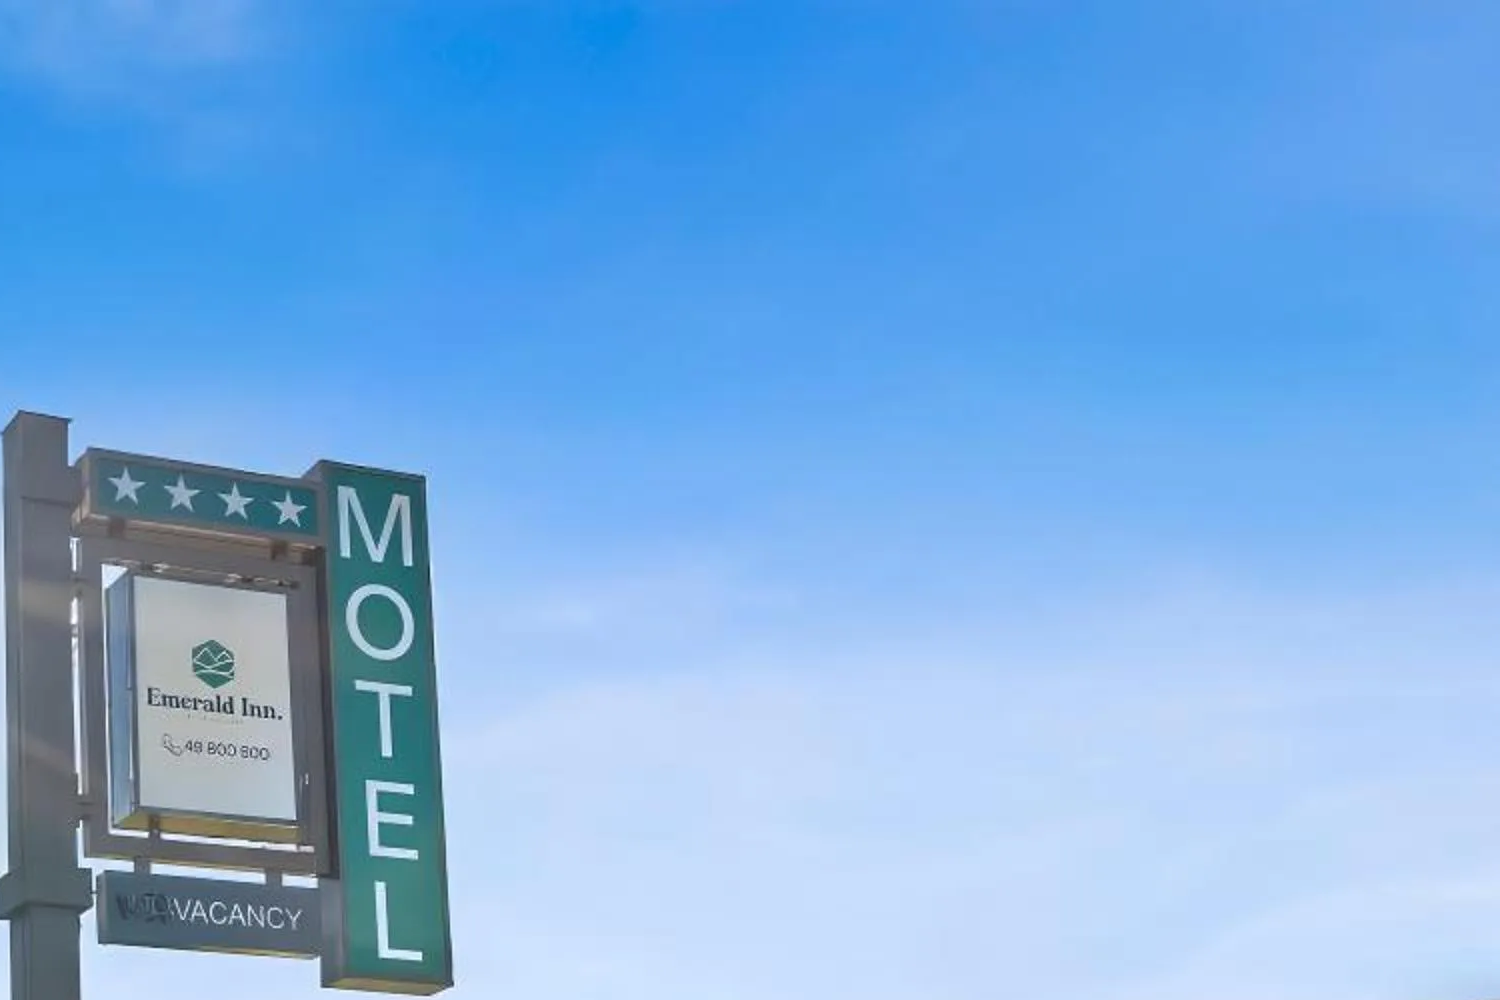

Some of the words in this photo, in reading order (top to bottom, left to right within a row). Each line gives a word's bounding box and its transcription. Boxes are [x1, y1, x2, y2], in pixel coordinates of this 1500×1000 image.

[147, 687, 234, 714] Emerald
[241, 697, 283, 720] Inn.
[337, 485, 423, 961] MOTEL
[172, 898, 303, 930] VACANCY
